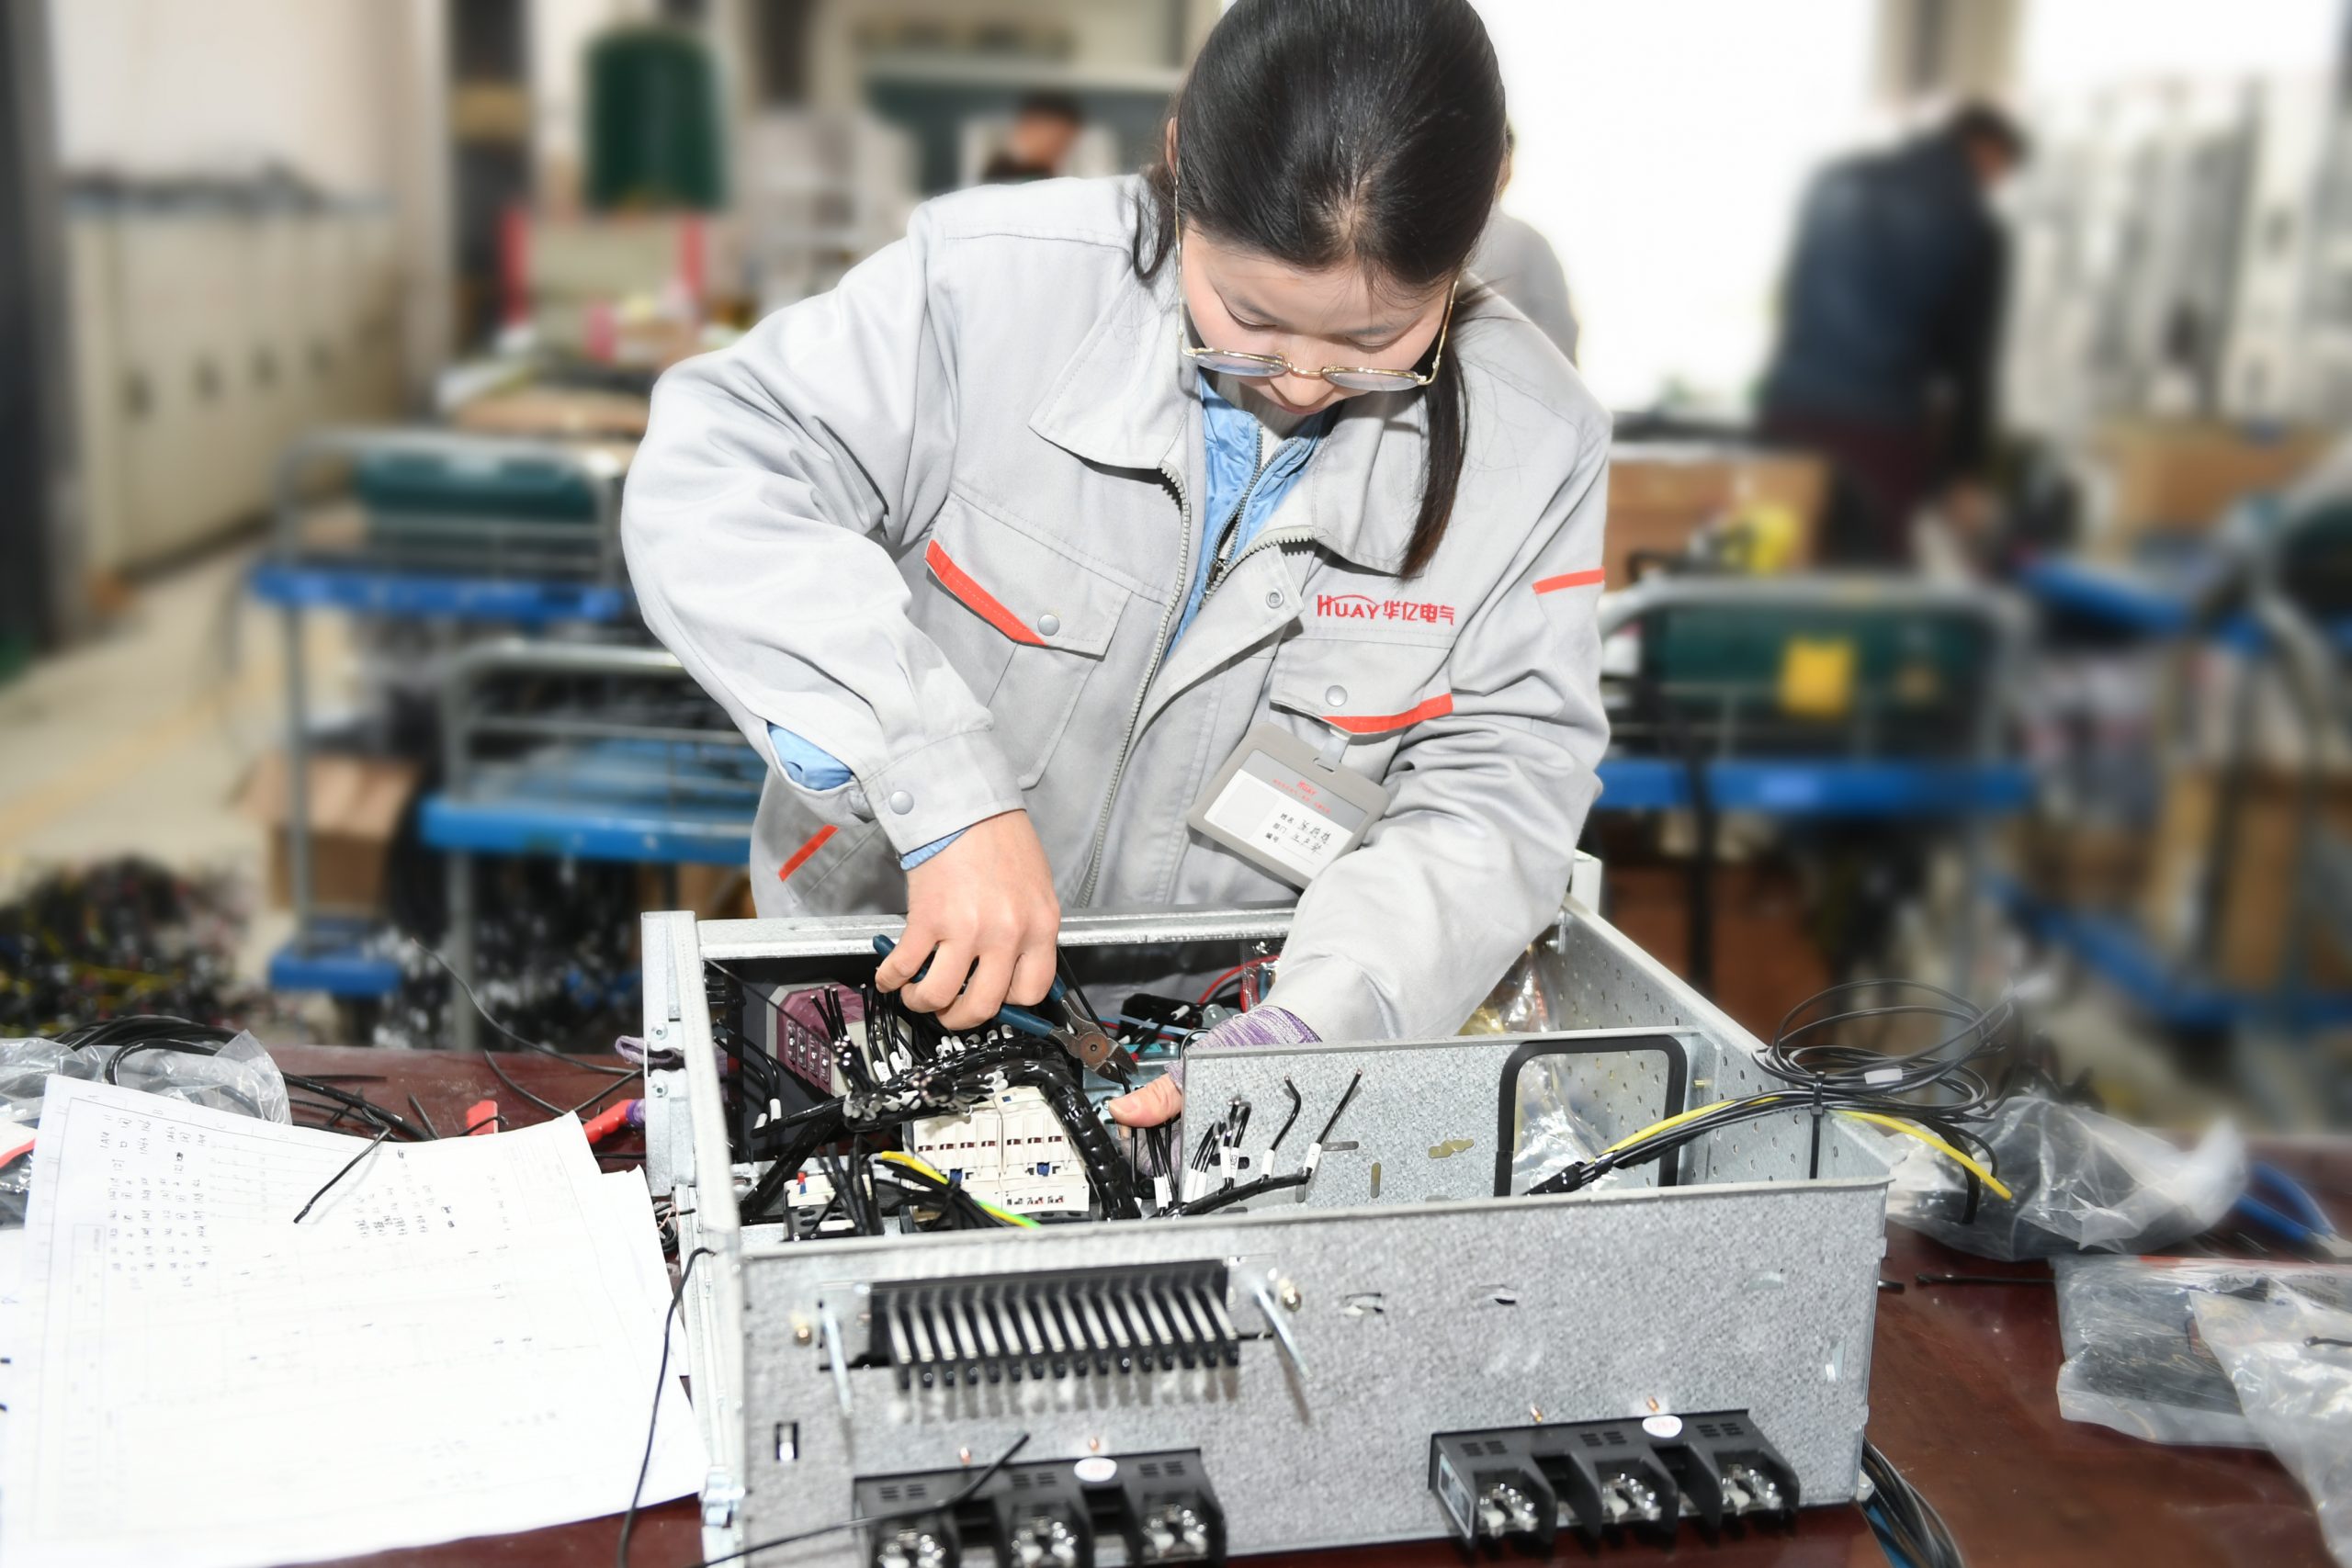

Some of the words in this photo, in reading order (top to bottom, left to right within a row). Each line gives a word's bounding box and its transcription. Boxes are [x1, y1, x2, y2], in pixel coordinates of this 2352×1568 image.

[1317, 594, 1380, 620] HUAY
[1383, 599, 1455, 626] 华亿电气
